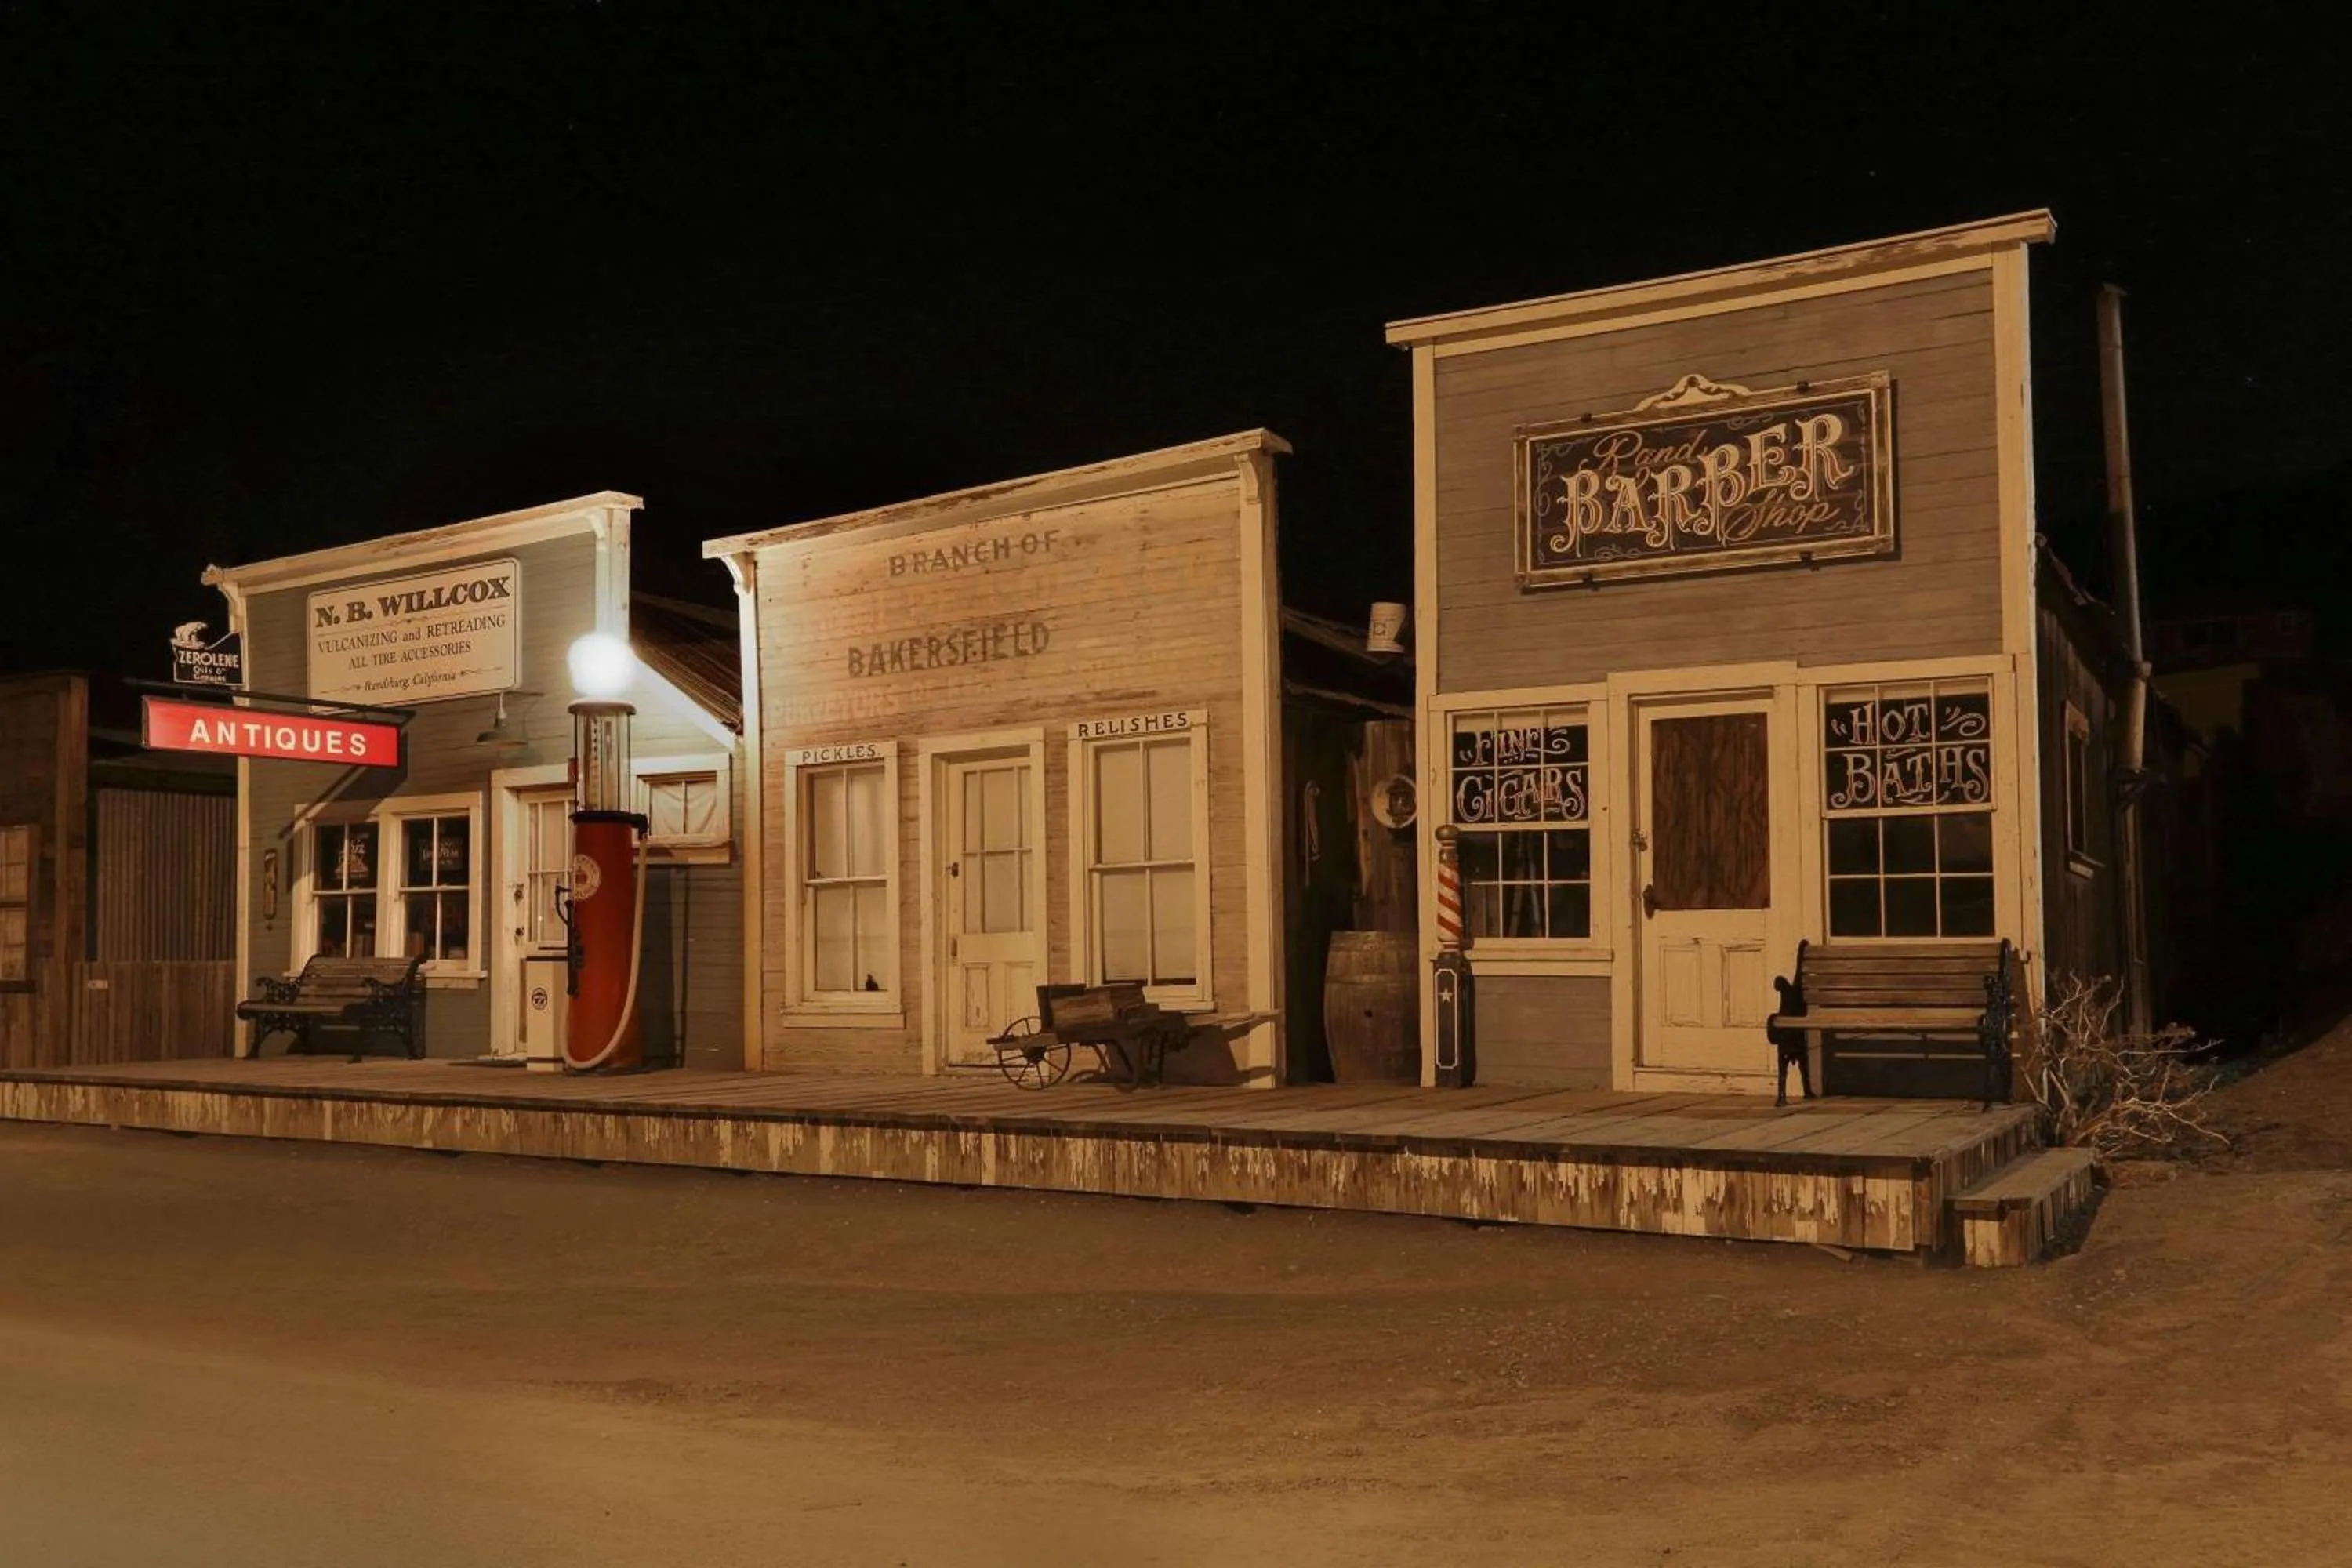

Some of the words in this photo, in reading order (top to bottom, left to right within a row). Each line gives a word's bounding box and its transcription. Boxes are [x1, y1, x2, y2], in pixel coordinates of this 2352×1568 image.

[1592, 429, 1708, 474] Rand
[1550, 413, 1853, 557] BARBER
[1725, 488, 1841, 540] Shop
[889, 535, 1010, 577] BRANCH
[1021, 529, 1061, 556] OF
[315, 605, 341, 627] N.
[347, 601, 373, 623] B.
[378, 576, 510, 616] WILLCOX
[318, 629, 398, 654] VULCANIZING
[402, 630, 421, 642] and
[426, 614, 506, 639] RETREADING
[348, 656, 368, 670] ALL
[373, 651, 397, 666] TIRE
[401, 641, 472, 662] ACCESSORIES
[848, 620, 1051, 679] BAKERSFIELD
[178, 651, 239, 667] ZEROLENE
[190, 719, 367, 757] ANTIQUES
[1078, 711, 1189, 738] RELISHES
[1849, 702, 1931, 745] HOT
[1471, 728, 1543, 766] FINE
[1456, 768, 1586, 822] CIGARS
[1831, 746, 1990, 808] BATHS
